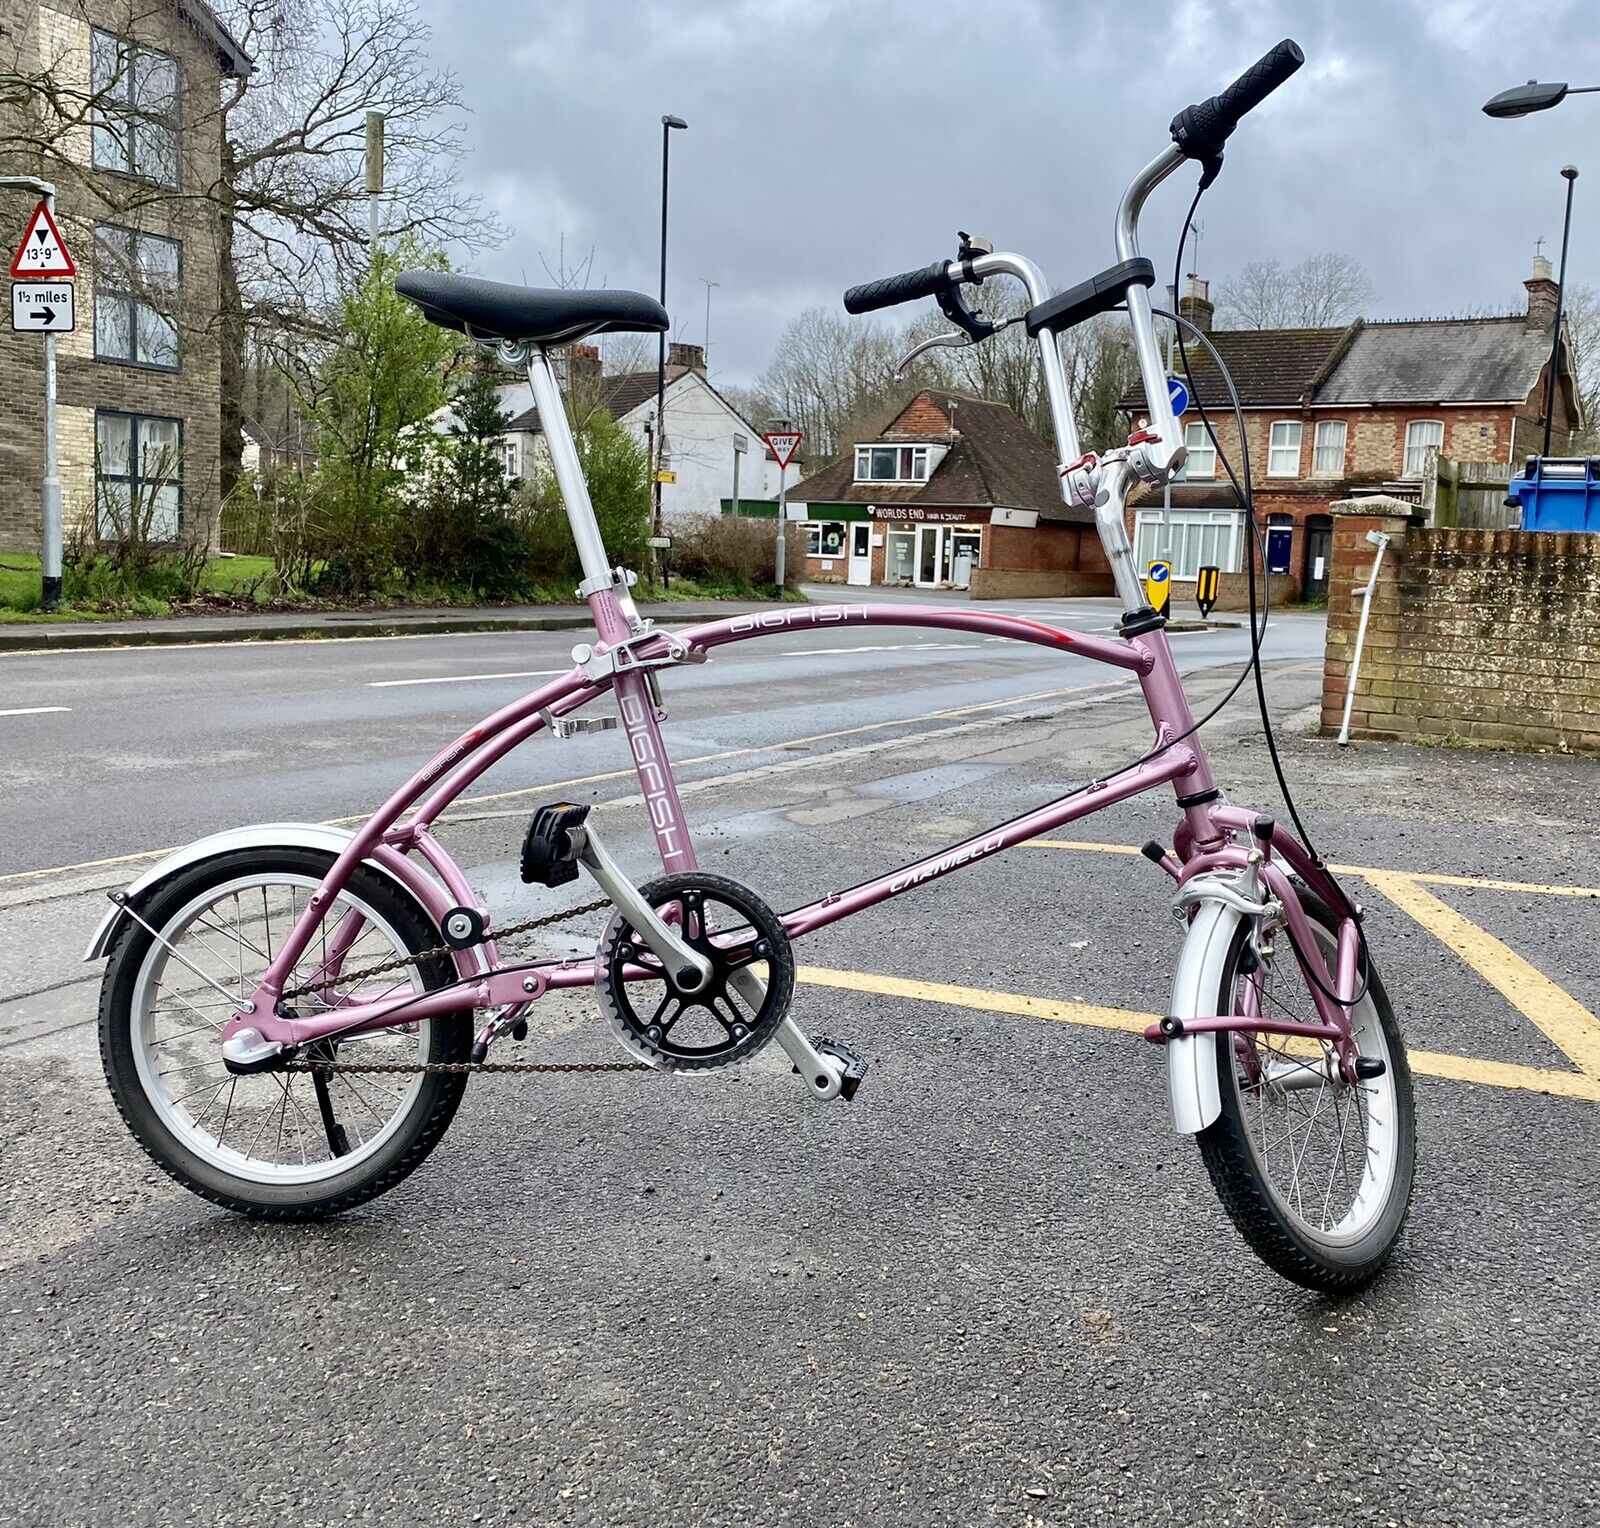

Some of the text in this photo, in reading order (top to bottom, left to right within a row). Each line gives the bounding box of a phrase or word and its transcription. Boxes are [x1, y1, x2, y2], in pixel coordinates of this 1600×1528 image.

[35, 290, 68, 303] miles
[772, 437, 794, 446] GIVE
[875, 508, 907, 519] WORLDS
[908, 509, 925, 520] END
[730, 604, 868, 633] BIGFISH
[421, 744, 465, 782] BIGFISH
[620, 693, 684, 859] BIGFISH
[889, 832, 1006, 893] CARNIELLI
